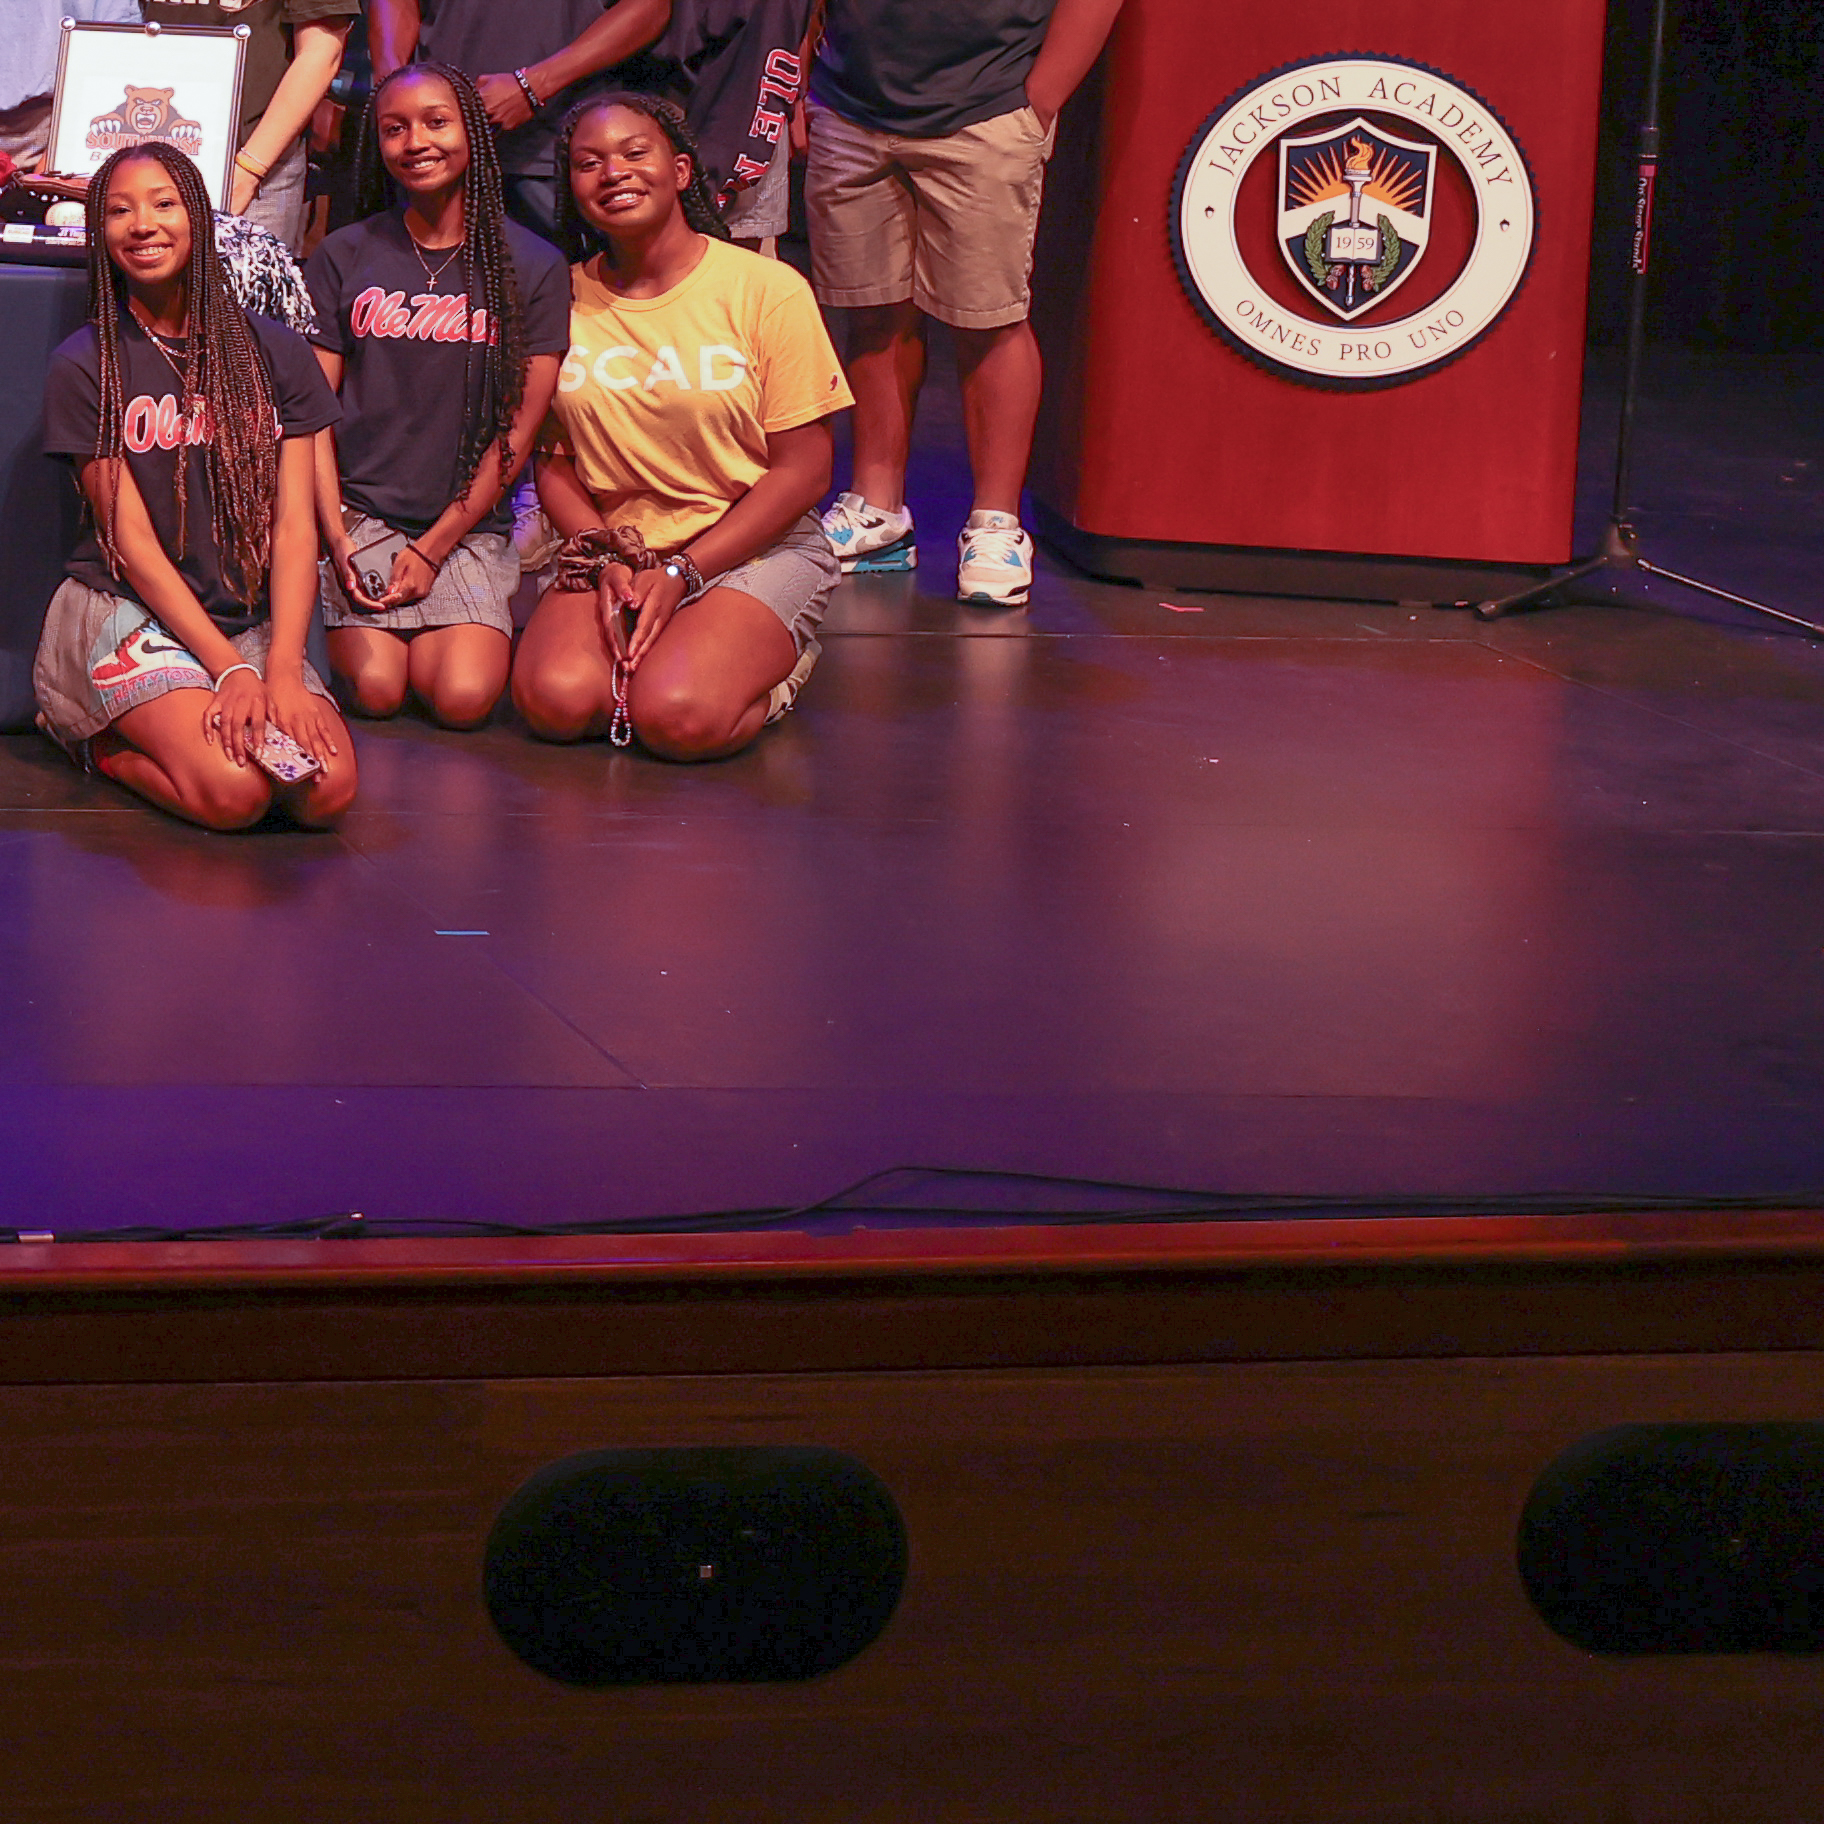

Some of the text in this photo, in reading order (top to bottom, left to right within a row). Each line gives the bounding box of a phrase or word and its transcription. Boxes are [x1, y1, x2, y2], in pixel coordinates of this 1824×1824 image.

[1208, 75, 1514, 191] JACKSON ACADEMY
[351, 286, 411, 338] Ole
[1236, 299, 1466, 362] OMNES PRO UNO
[558, 344, 746, 393] SCAD
